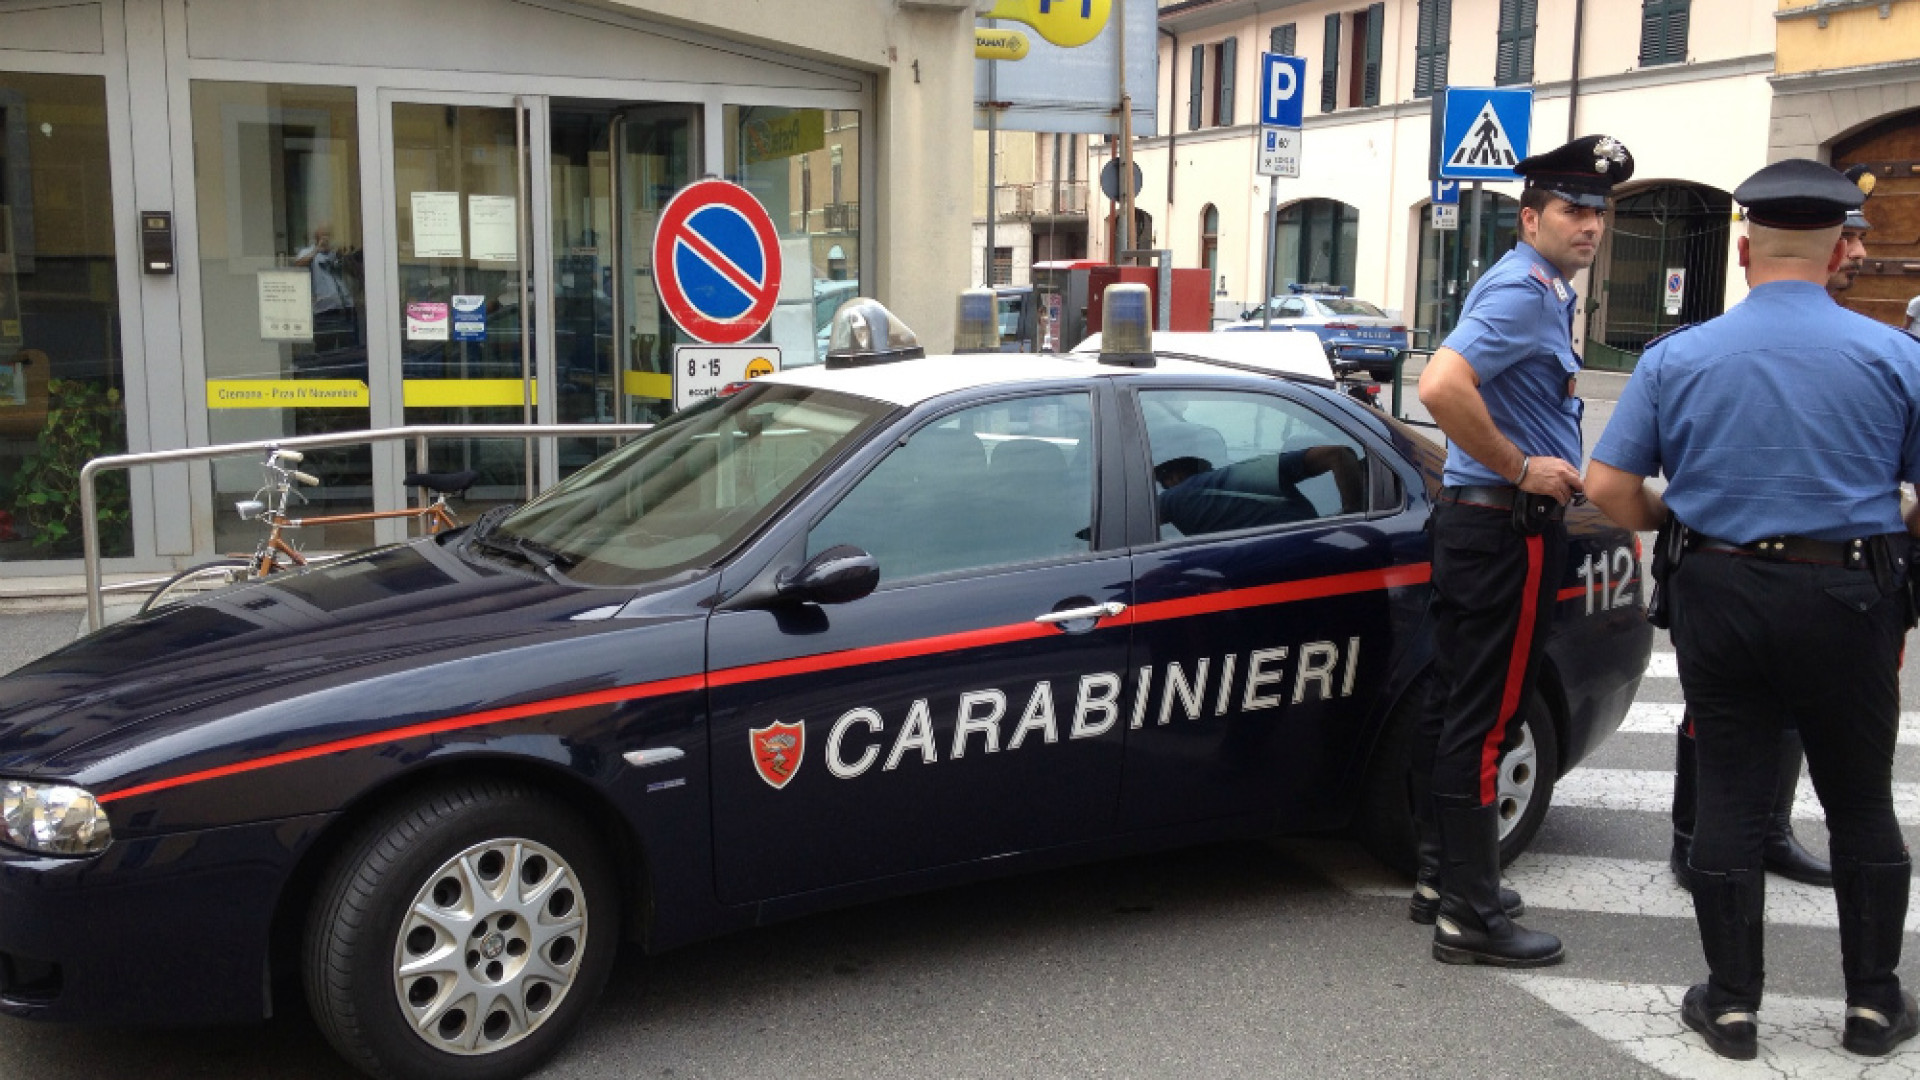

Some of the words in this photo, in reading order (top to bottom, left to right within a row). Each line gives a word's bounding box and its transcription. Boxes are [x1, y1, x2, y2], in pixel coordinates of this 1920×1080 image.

[911, 59, 920, 84] 1
[1269, 61, 1297, 119] P
[1356, 331, 1391, 339] POLIZIA
[688, 358, 696, 377] 8
[218, 388, 262, 400] Cremona
[308, 387, 358, 398] Novembre
[1577, 546, 1634, 616] 112
[824, 635, 1361, 779] CARABINIERI
